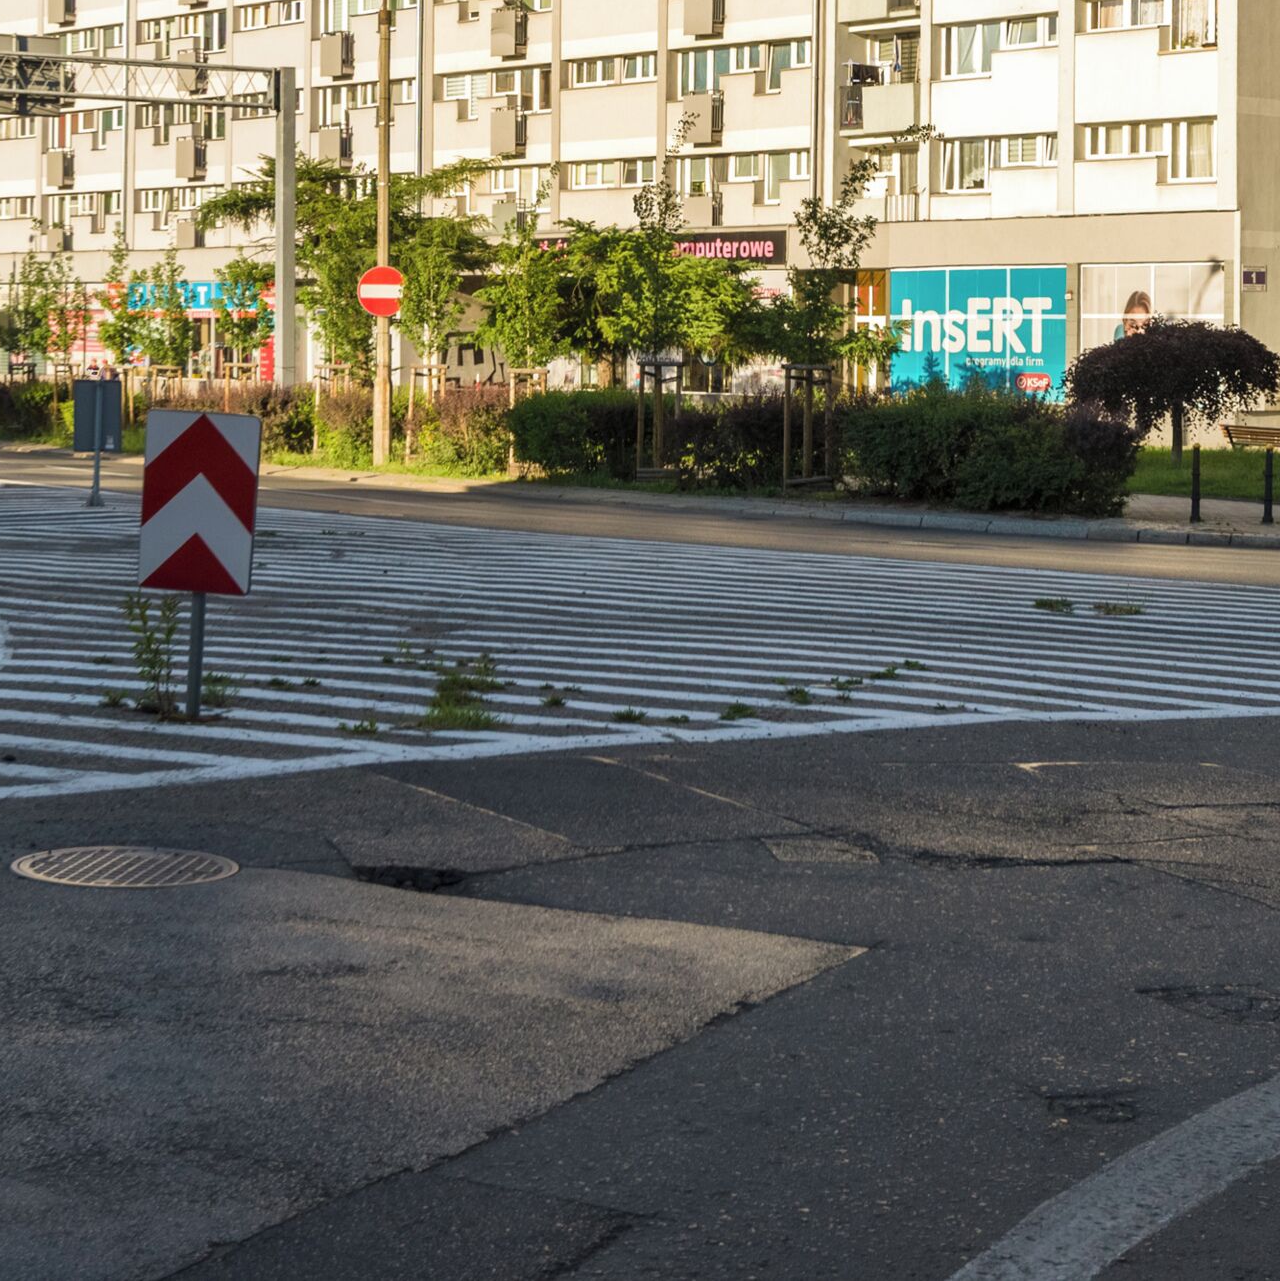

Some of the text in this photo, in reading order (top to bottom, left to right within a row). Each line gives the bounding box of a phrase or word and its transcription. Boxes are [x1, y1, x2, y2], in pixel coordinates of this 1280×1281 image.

[671, 238, 774, 258] omputerowe
[1251, 271, 1257, 284] 1
[901, 297, 1053, 354] InsERT
[1010, 356, 1024, 366] dla
[1026, 356, 1044, 366] firm
